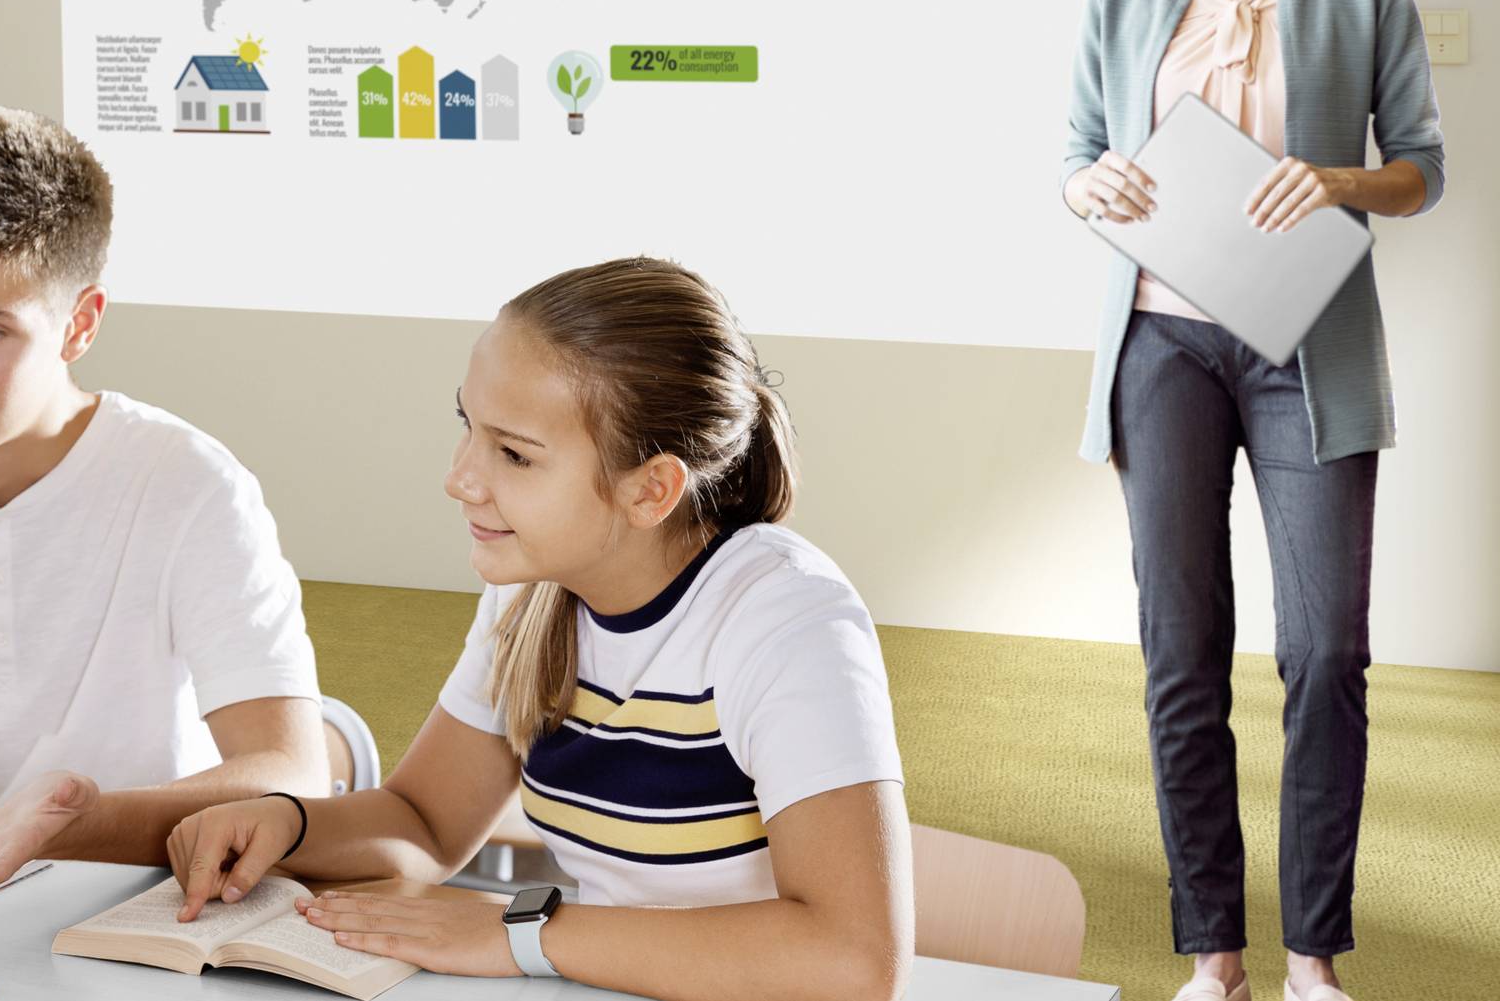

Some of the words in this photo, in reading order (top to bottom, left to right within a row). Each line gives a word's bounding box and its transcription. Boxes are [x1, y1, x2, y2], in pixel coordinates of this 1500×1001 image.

[630, 50, 677, 71] 22%
[679, 48, 688, 59] of
[690, 48, 700, 59] all
[703, 50, 735, 62] energy
[679, 62, 739, 75] consumption
[362, 92, 388, 105] 31%
[402, 92, 432, 106] 42%
[445, 92, 475, 107] 24%
